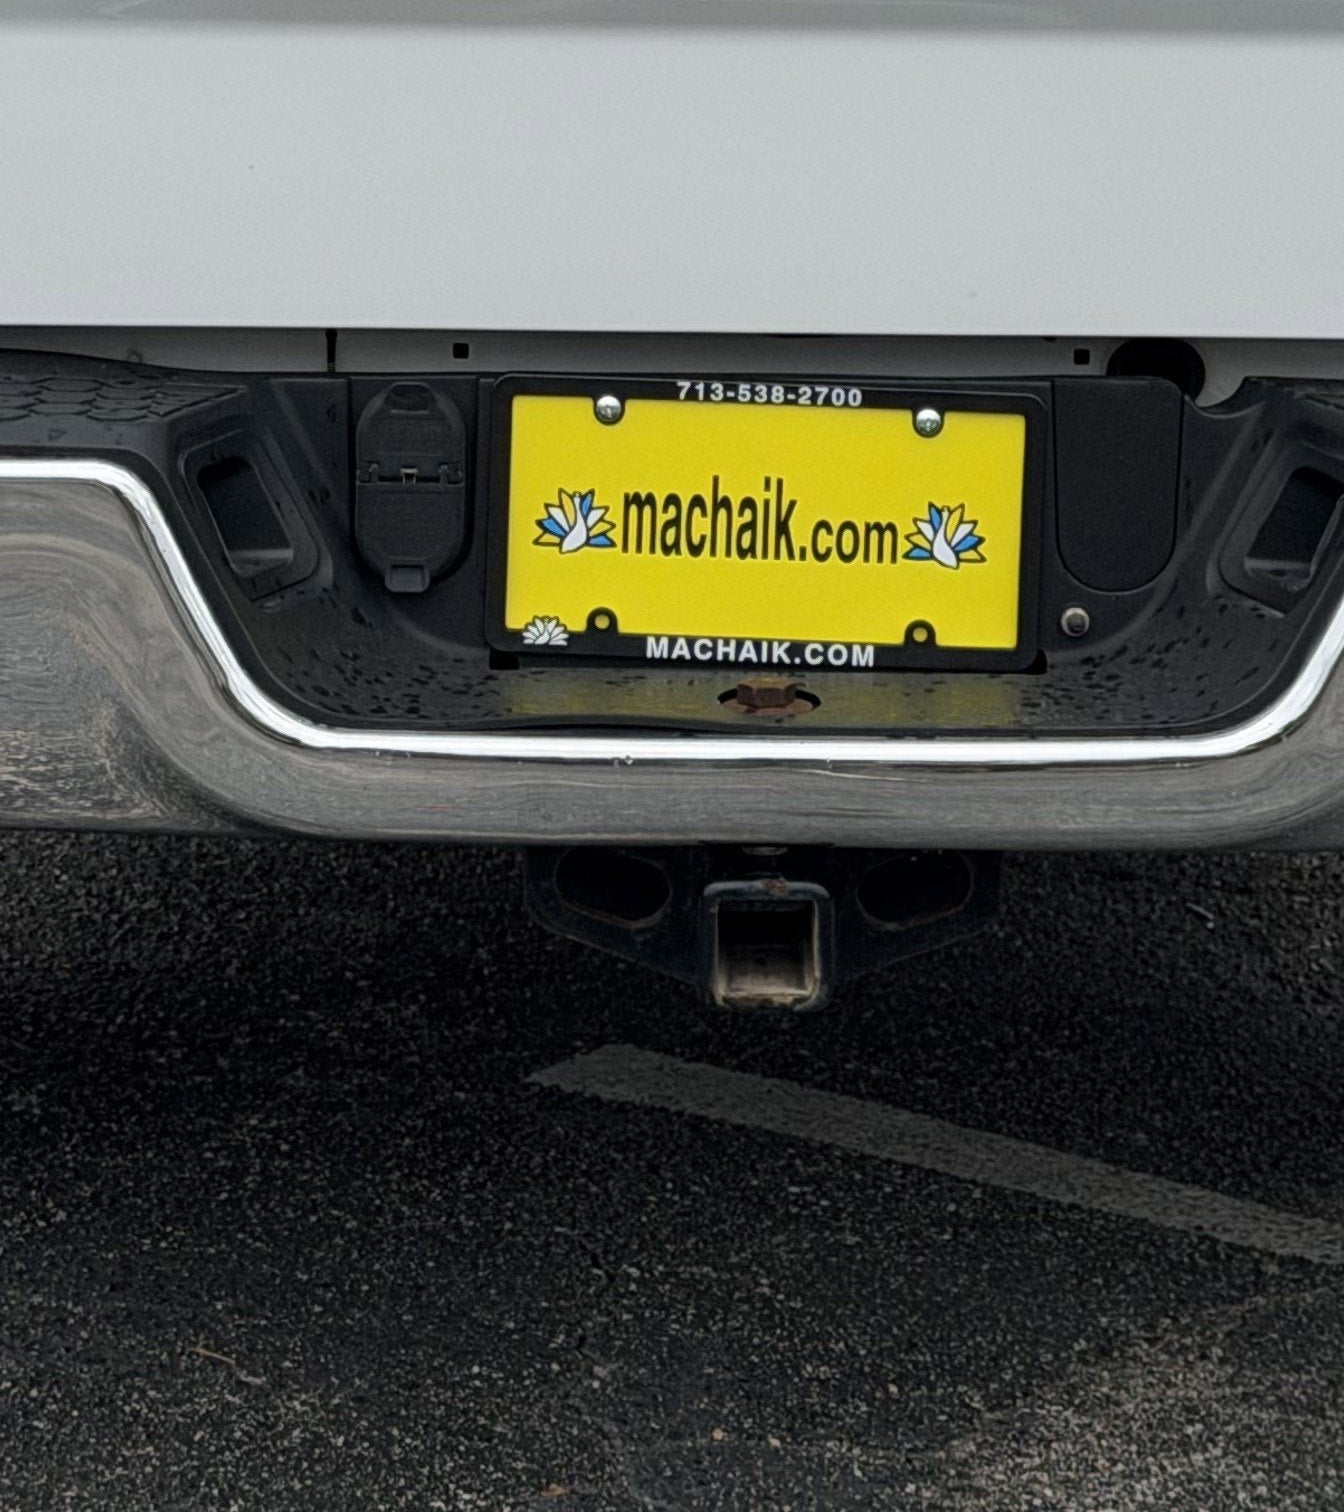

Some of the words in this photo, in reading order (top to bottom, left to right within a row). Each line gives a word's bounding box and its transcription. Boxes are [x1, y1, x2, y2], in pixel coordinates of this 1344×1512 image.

[676, 380, 863, 408] 713-538-2700
[620, 474, 899, 565] machaik.com
[645, 635, 875, 668] MACHAIK.COM
